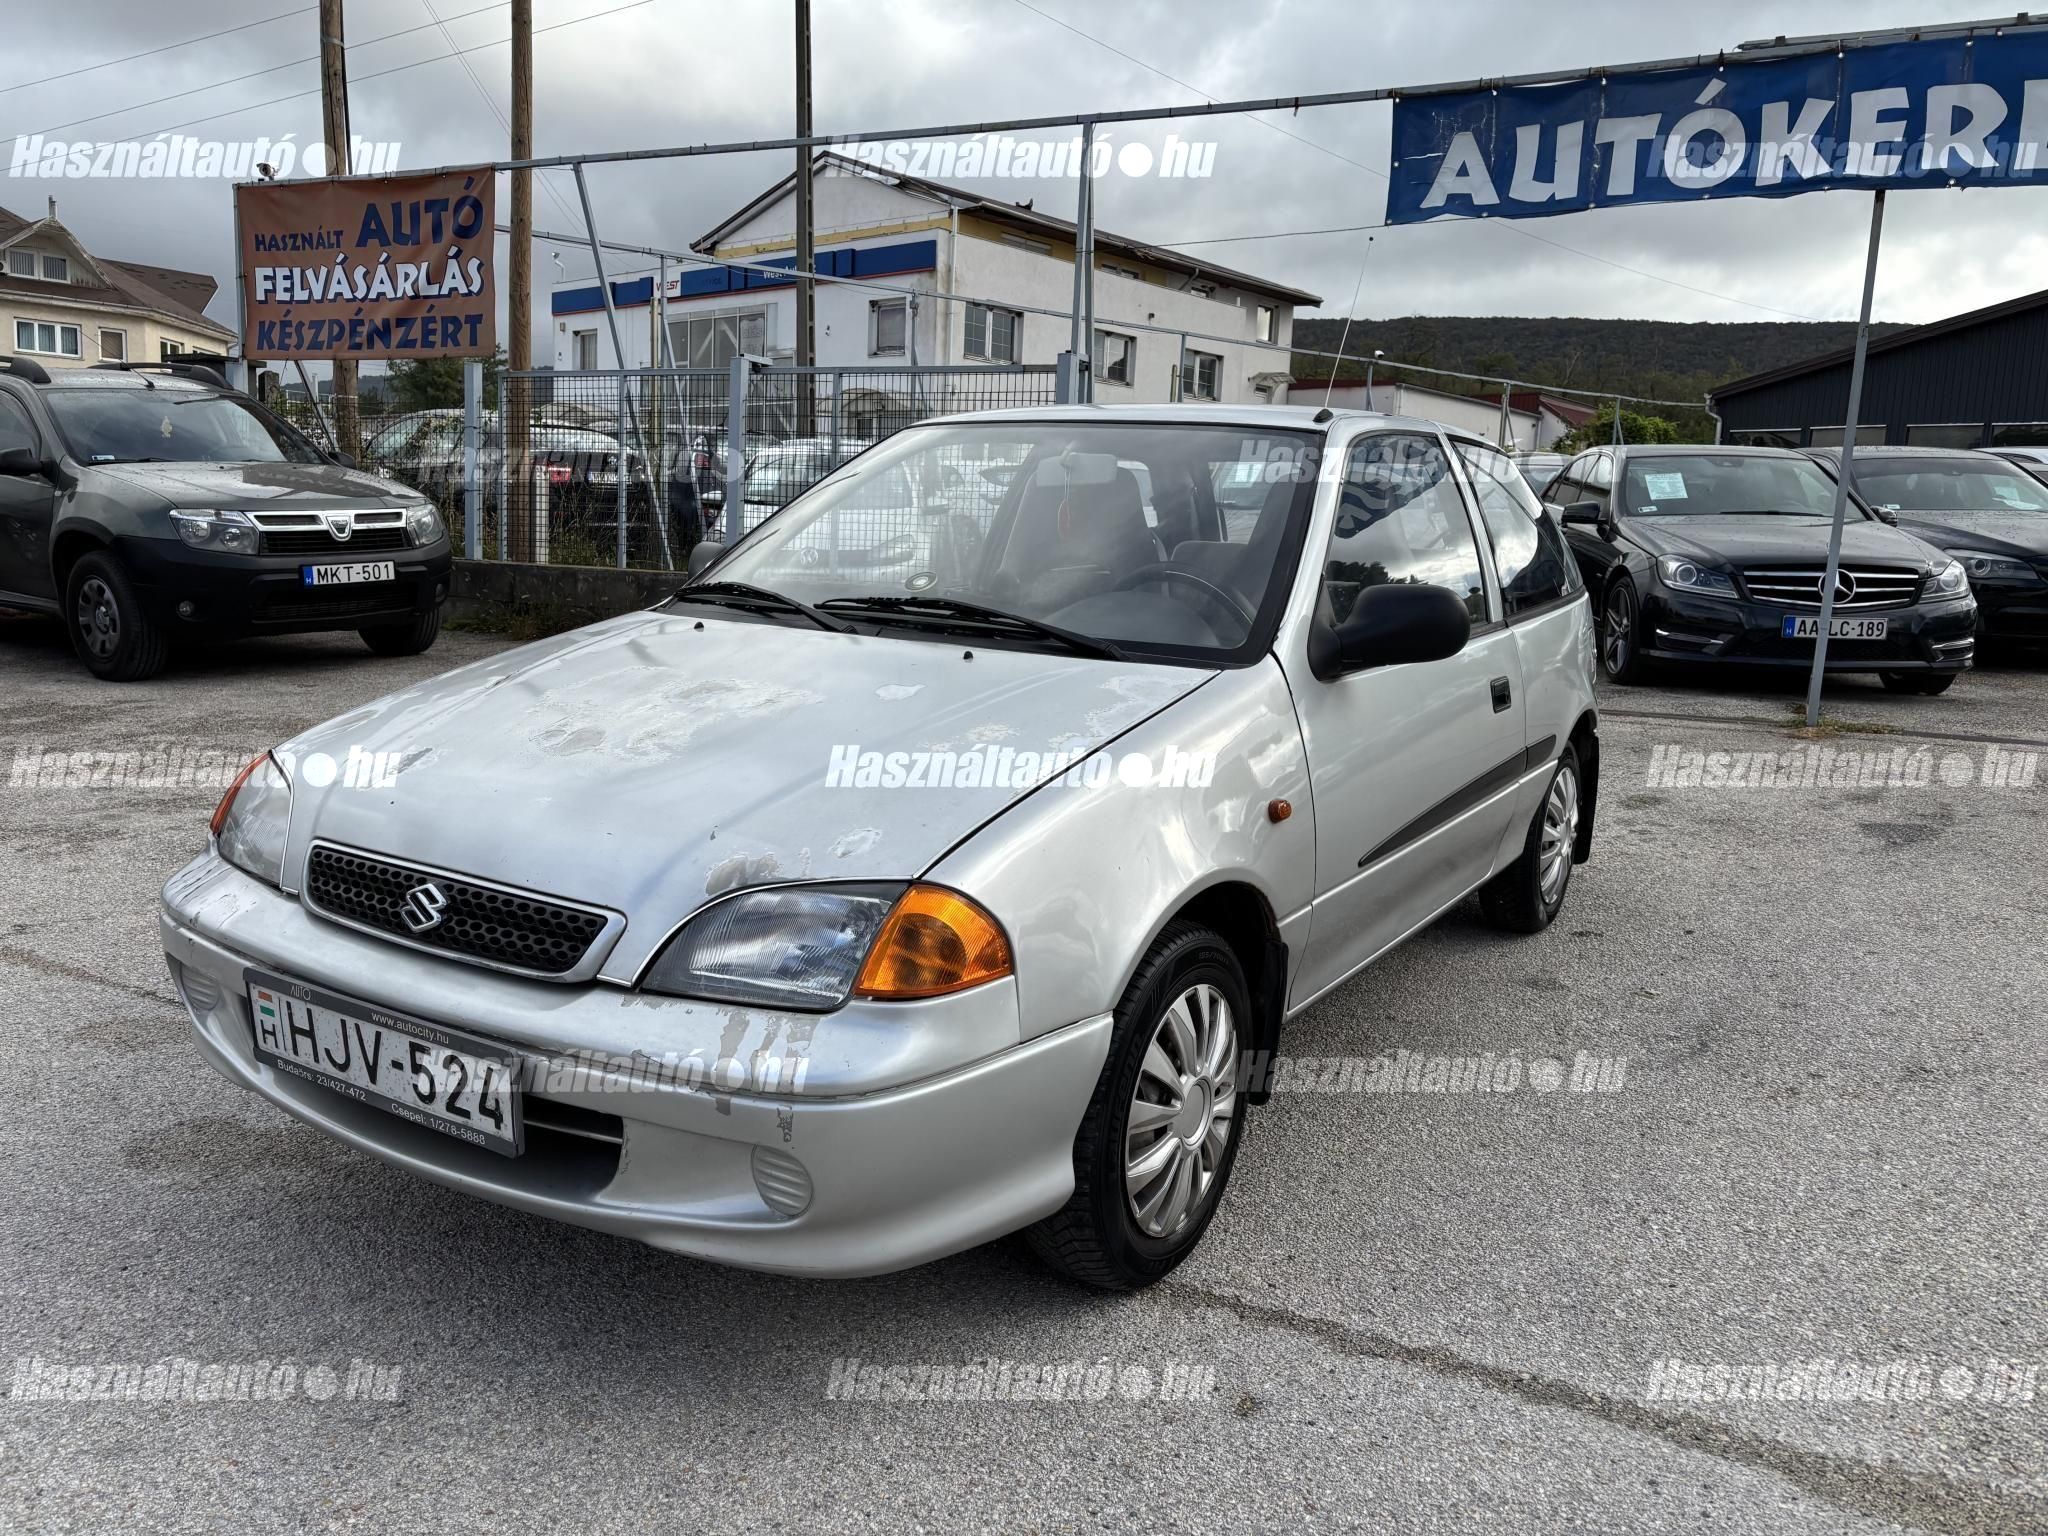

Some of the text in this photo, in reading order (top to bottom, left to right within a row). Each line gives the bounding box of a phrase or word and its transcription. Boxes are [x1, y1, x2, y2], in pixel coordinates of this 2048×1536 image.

[255, 176, 483, 251] HASZNÁLT AUTÓ
[254, 245, 485, 304] FELVÁSÁRLÁS
[257, 304, 483, 350] KÉSZPÉNZÉRT
[316, 563, 391, 583] MKT-501
[1829, 620, 1885, 637] LC-189
[371, 1012, 449, 1044] www.autocity.hu
[260, 1001, 503, 1130] H HJV-524
[391, 1103, 427, 1125] Csepel:
[430, 1118, 486, 1144] 1/278-5888
